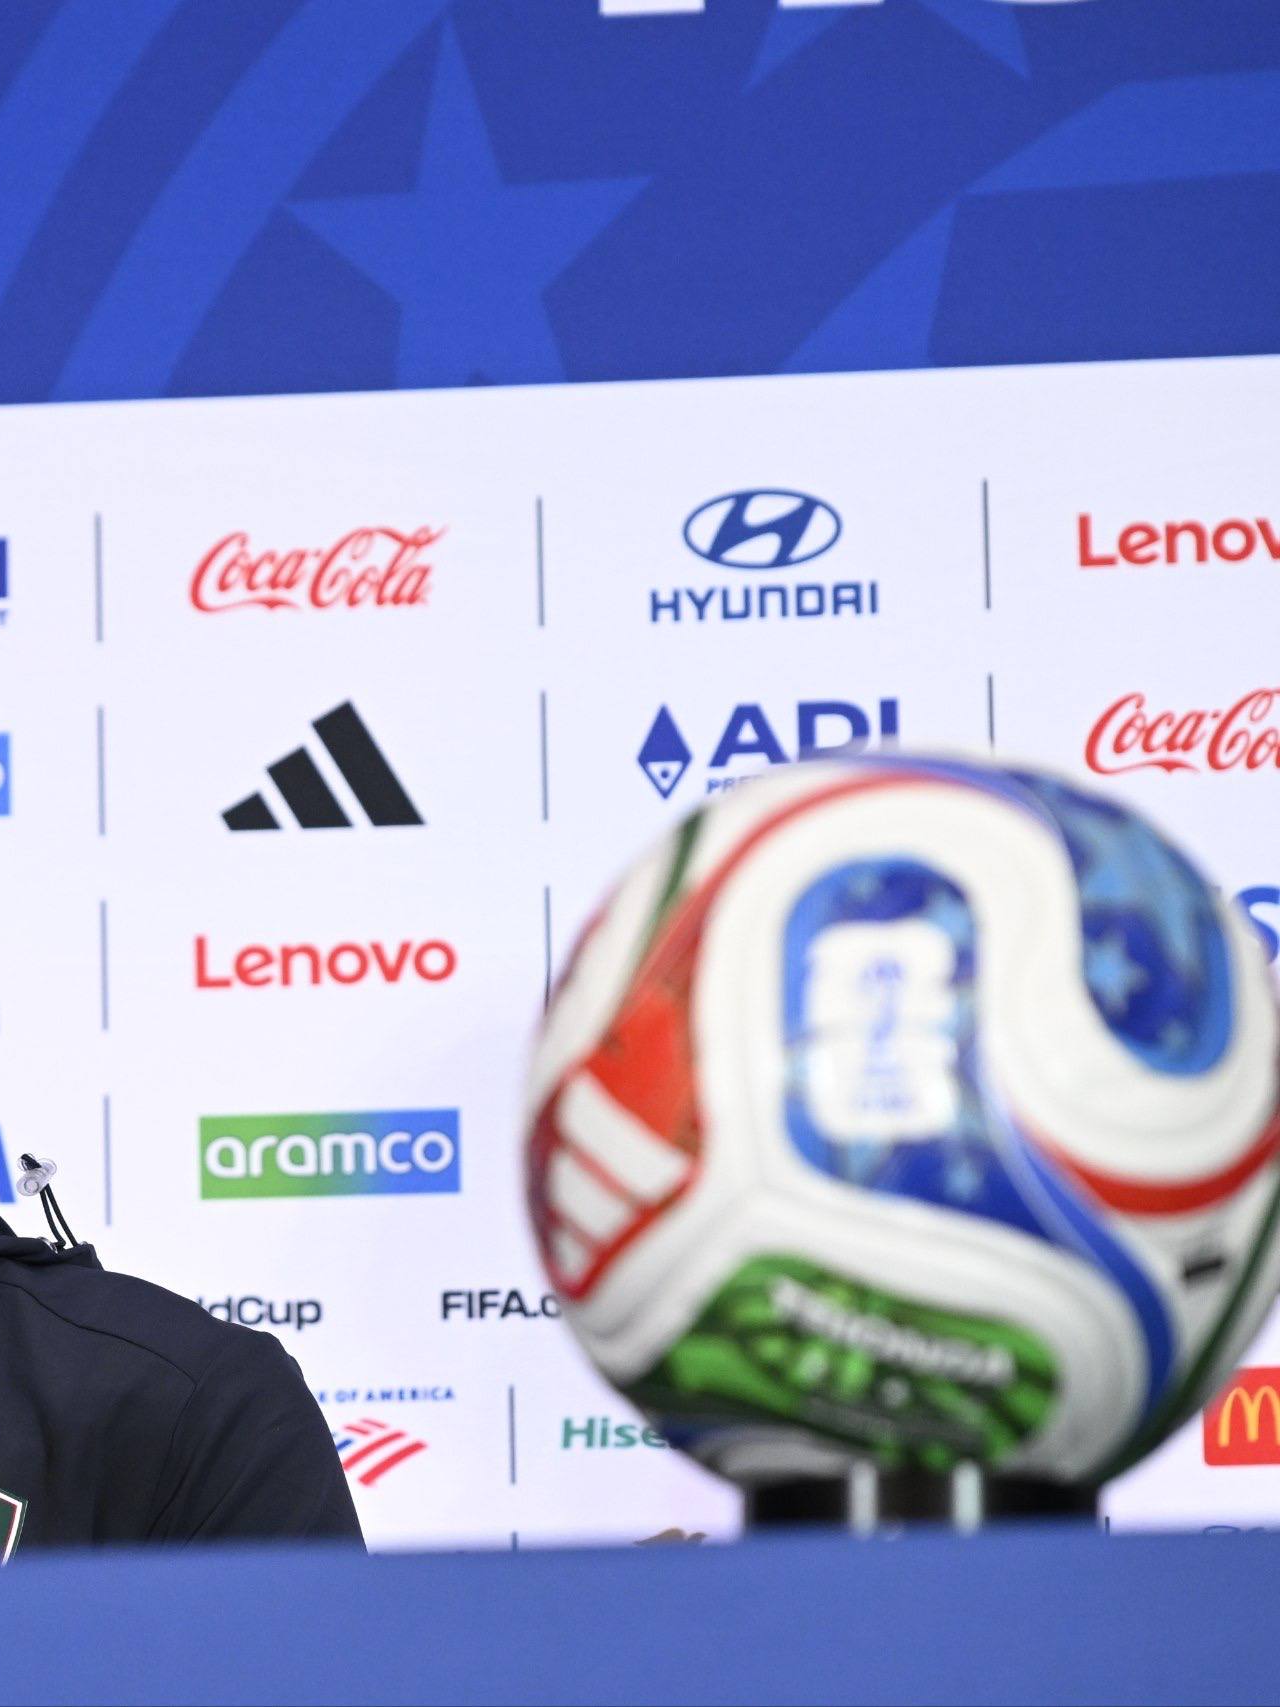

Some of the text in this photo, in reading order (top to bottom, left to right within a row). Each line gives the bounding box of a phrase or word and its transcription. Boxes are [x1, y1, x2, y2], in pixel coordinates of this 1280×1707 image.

[190, 526, 448, 613] Coca-Cola
[650, 581, 878, 623] HYUNDAI
[708, 697, 898, 767] ADI
[1084, 687, 1280, 775] Coca-Co
[194, 934, 458, 989] Lenovo
[205, 1130, 455, 1179] aramco
[366, 1384, 455, 1402] AMERICA
